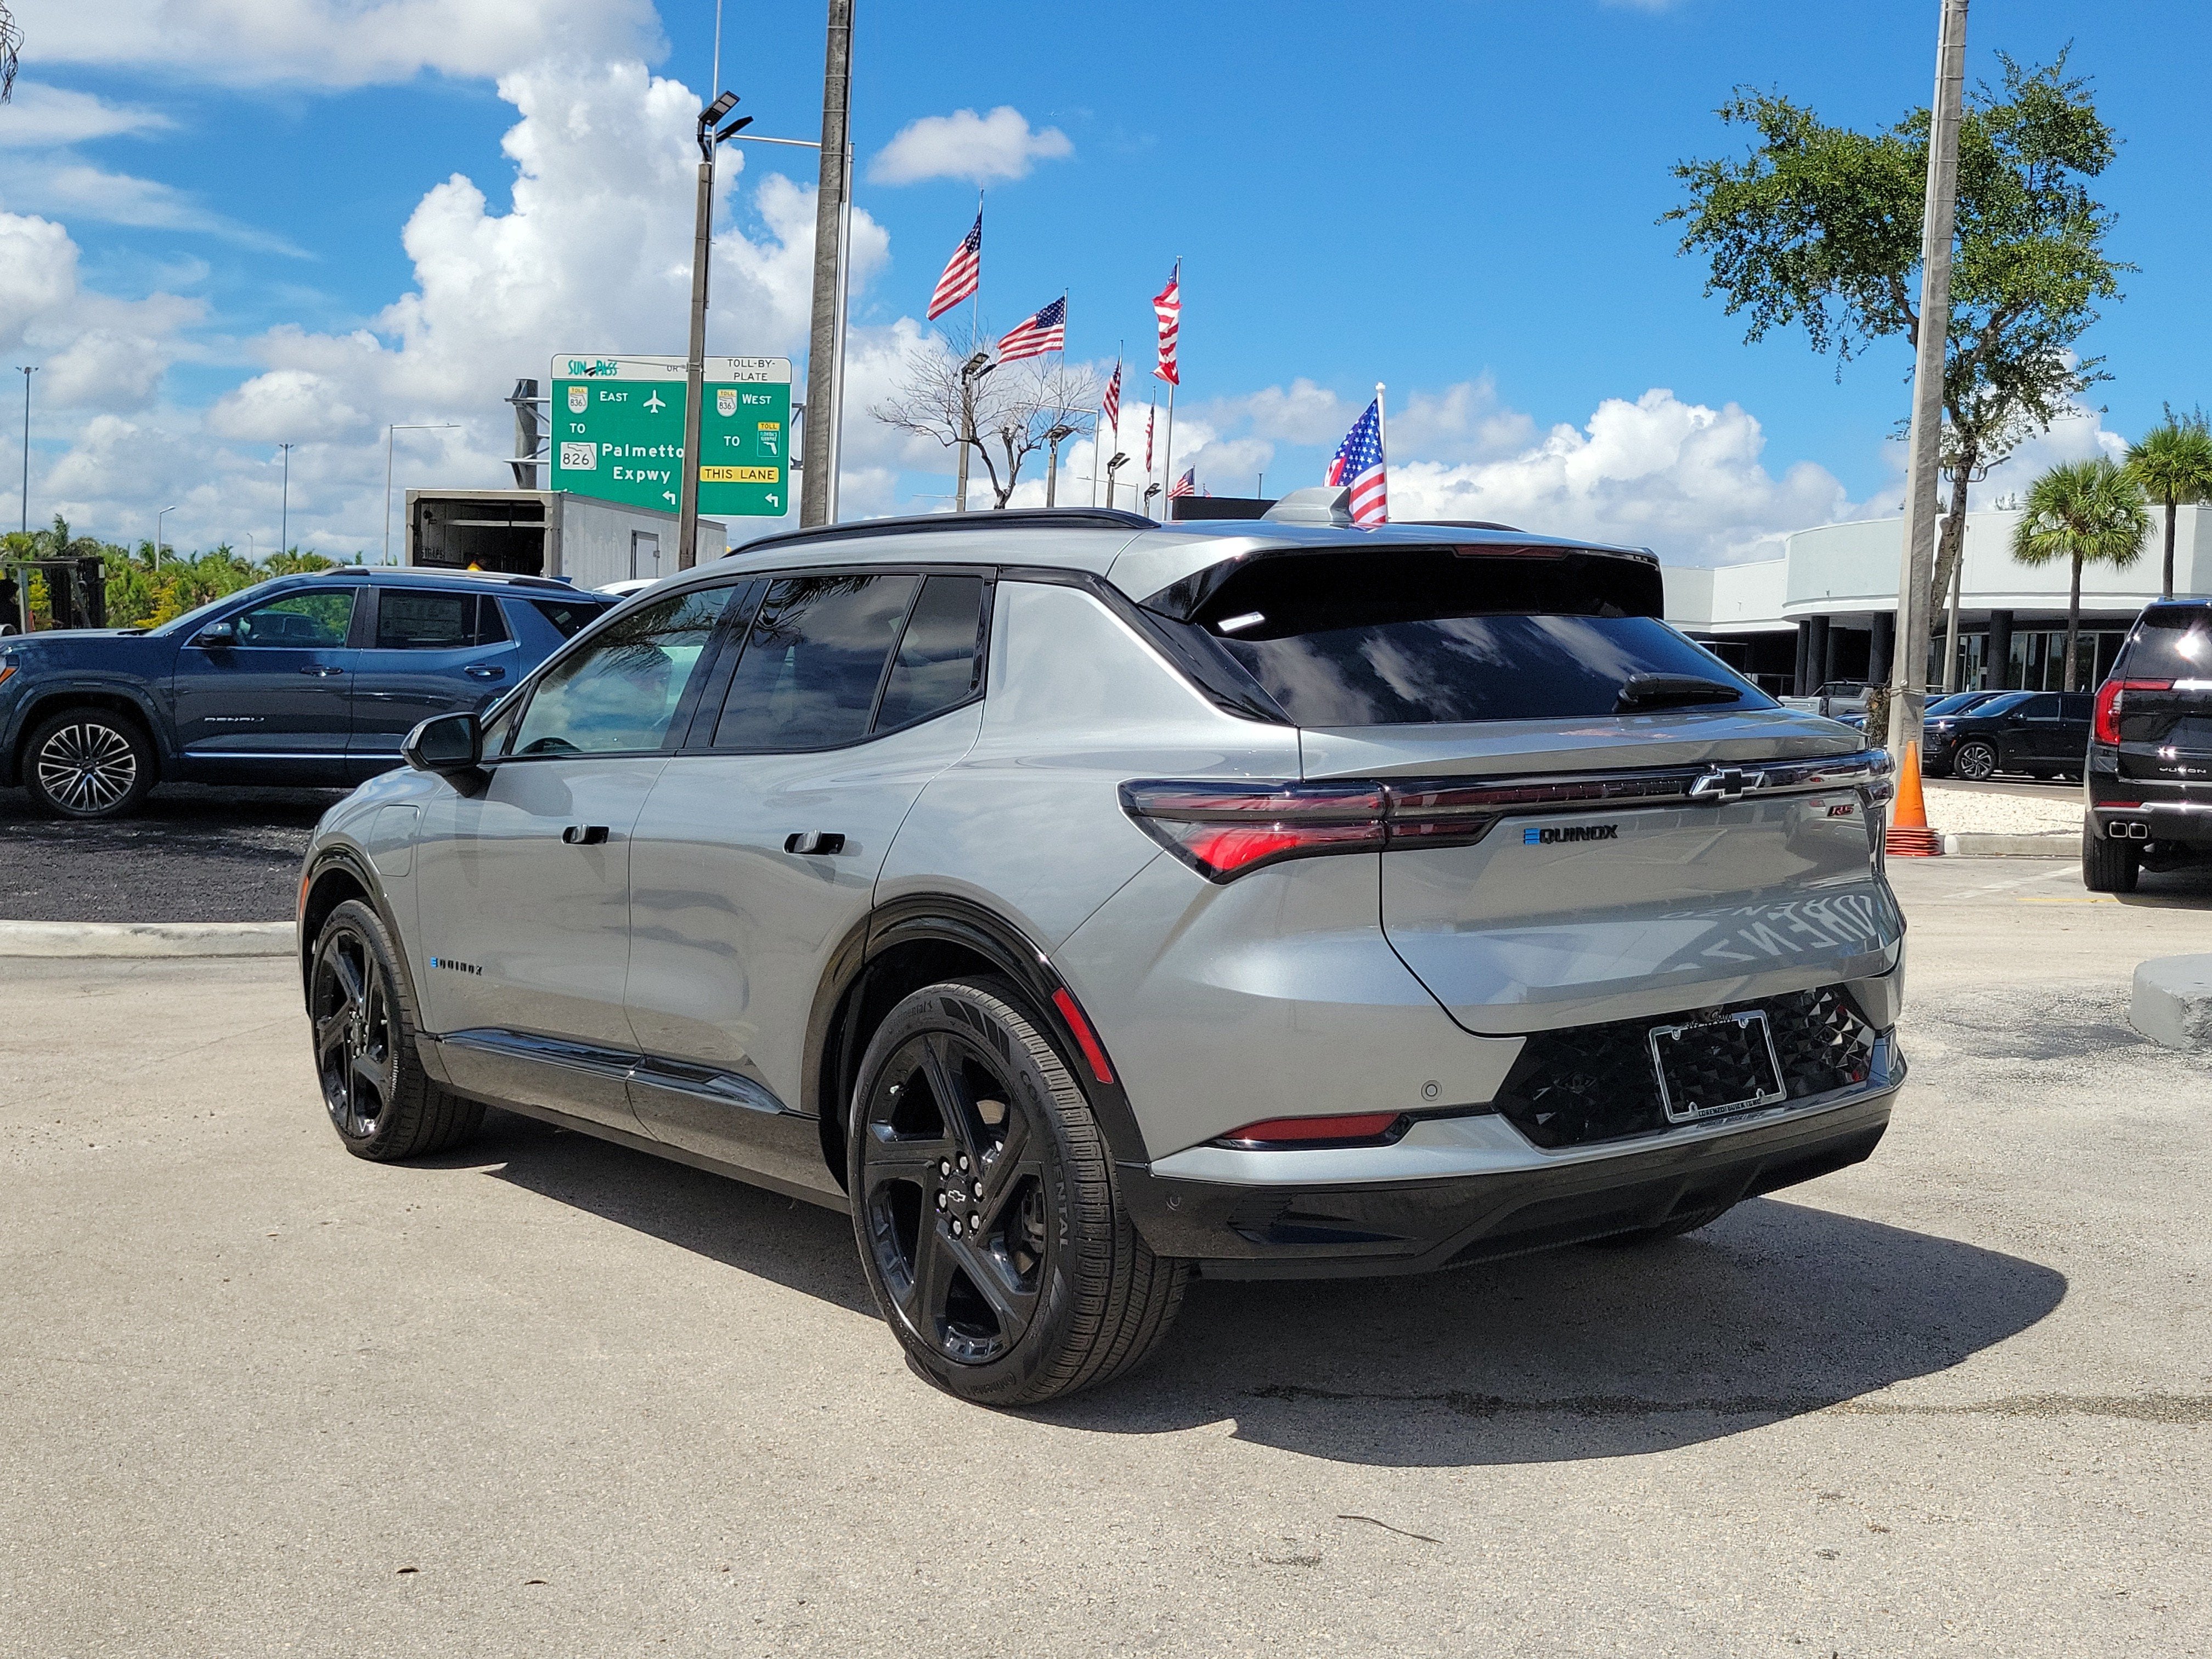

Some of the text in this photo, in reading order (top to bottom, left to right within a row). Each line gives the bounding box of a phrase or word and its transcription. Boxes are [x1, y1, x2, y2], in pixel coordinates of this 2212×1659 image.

[727, 359, 775, 368] TOLL-BY-
[734, 373, 768, 381] PLATE
[600, 391, 628, 402] EAST
[742, 394, 772, 404] WEST
[570, 399, 583, 407] 836
[719, 402, 732, 410] 836
[569, 423, 585, 433] TO
[724, 436, 740, 447] TO
[602, 443, 684, 458] Palmetto
[563, 453, 590, 465] 826
[613, 466, 671, 484] Expwy
[705, 469, 775, 480] THIS LANE
[1523, 825, 1618, 845] EQUINOX
[1698, 1107, 1724, 1117] LORENZO
